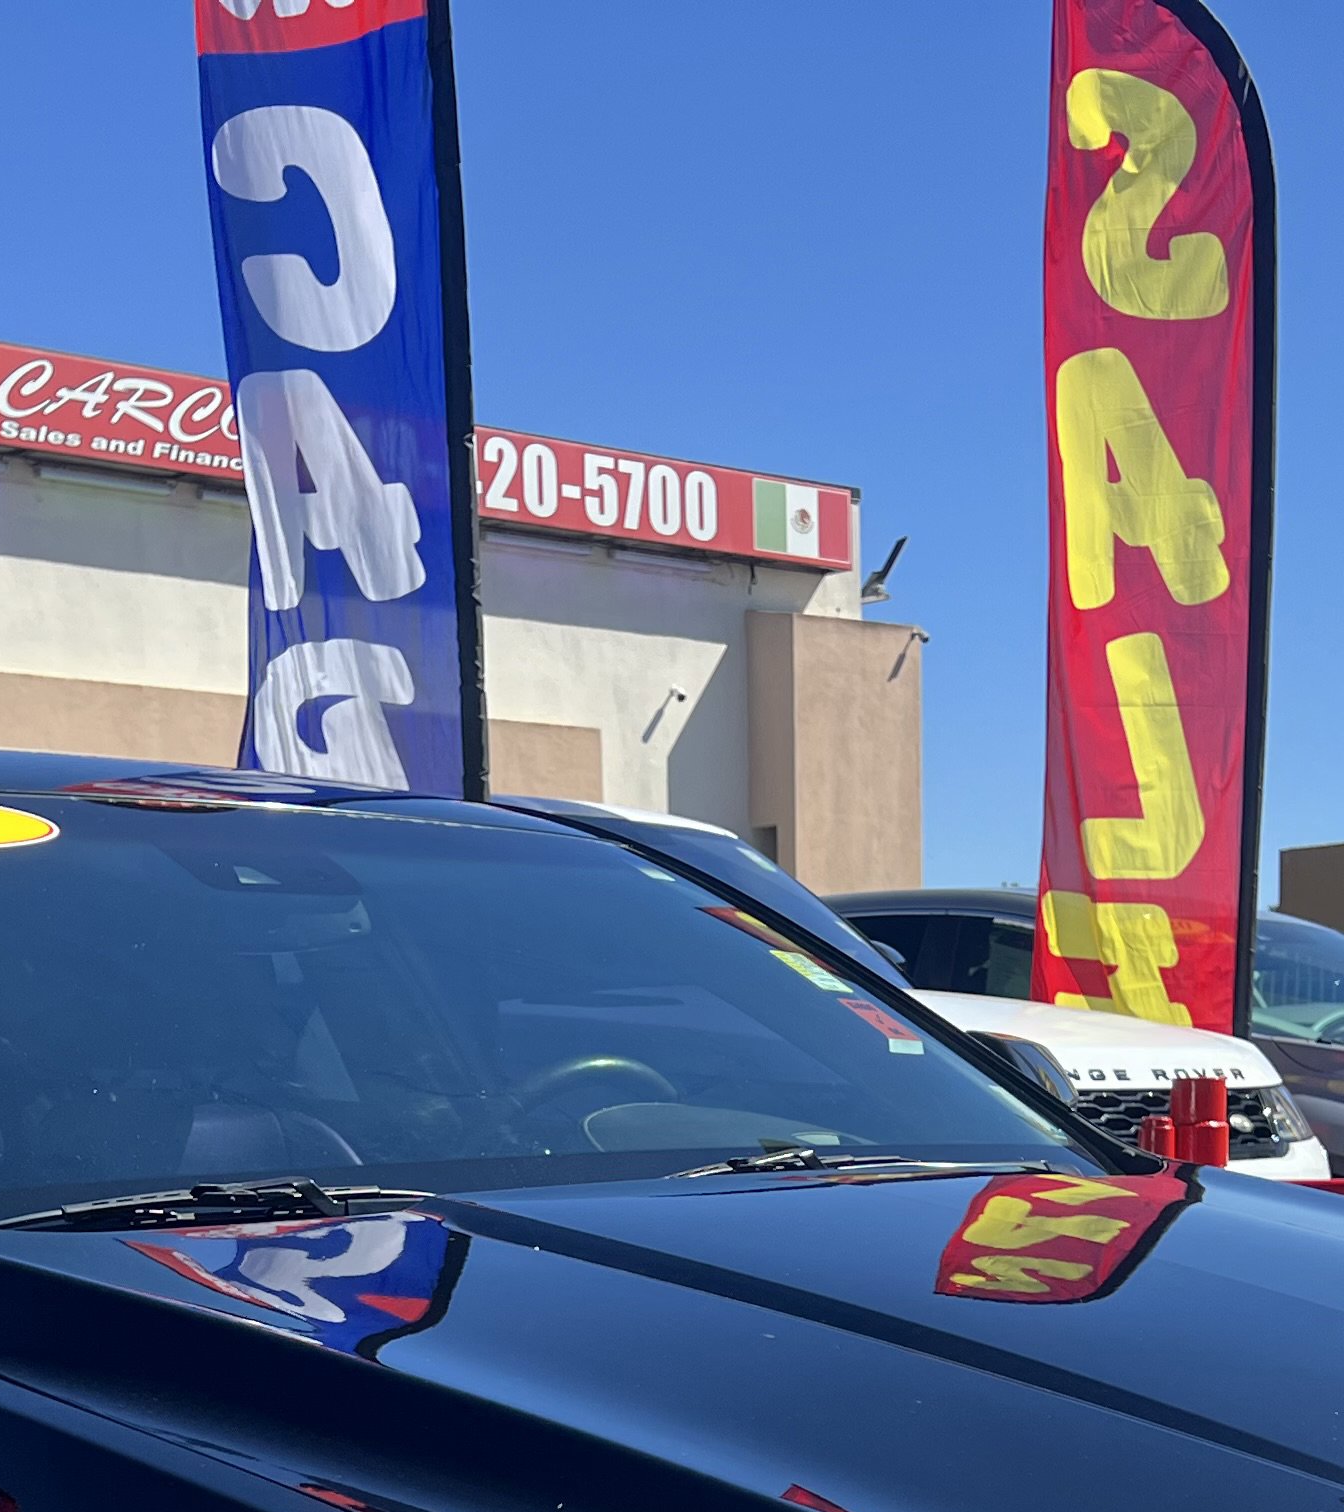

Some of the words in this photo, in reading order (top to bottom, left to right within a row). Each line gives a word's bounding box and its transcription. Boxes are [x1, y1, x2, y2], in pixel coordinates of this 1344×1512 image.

[0, 419, 83, 450] Sales
[90, 435, 145, 458] and
[152, 441, 244, 473] Financ
[473, 435, 718, 542] 20-5700
[1067, 1067, 1131, 1082] NGE
[1150, 1067, 1246, 1082] ROVER
